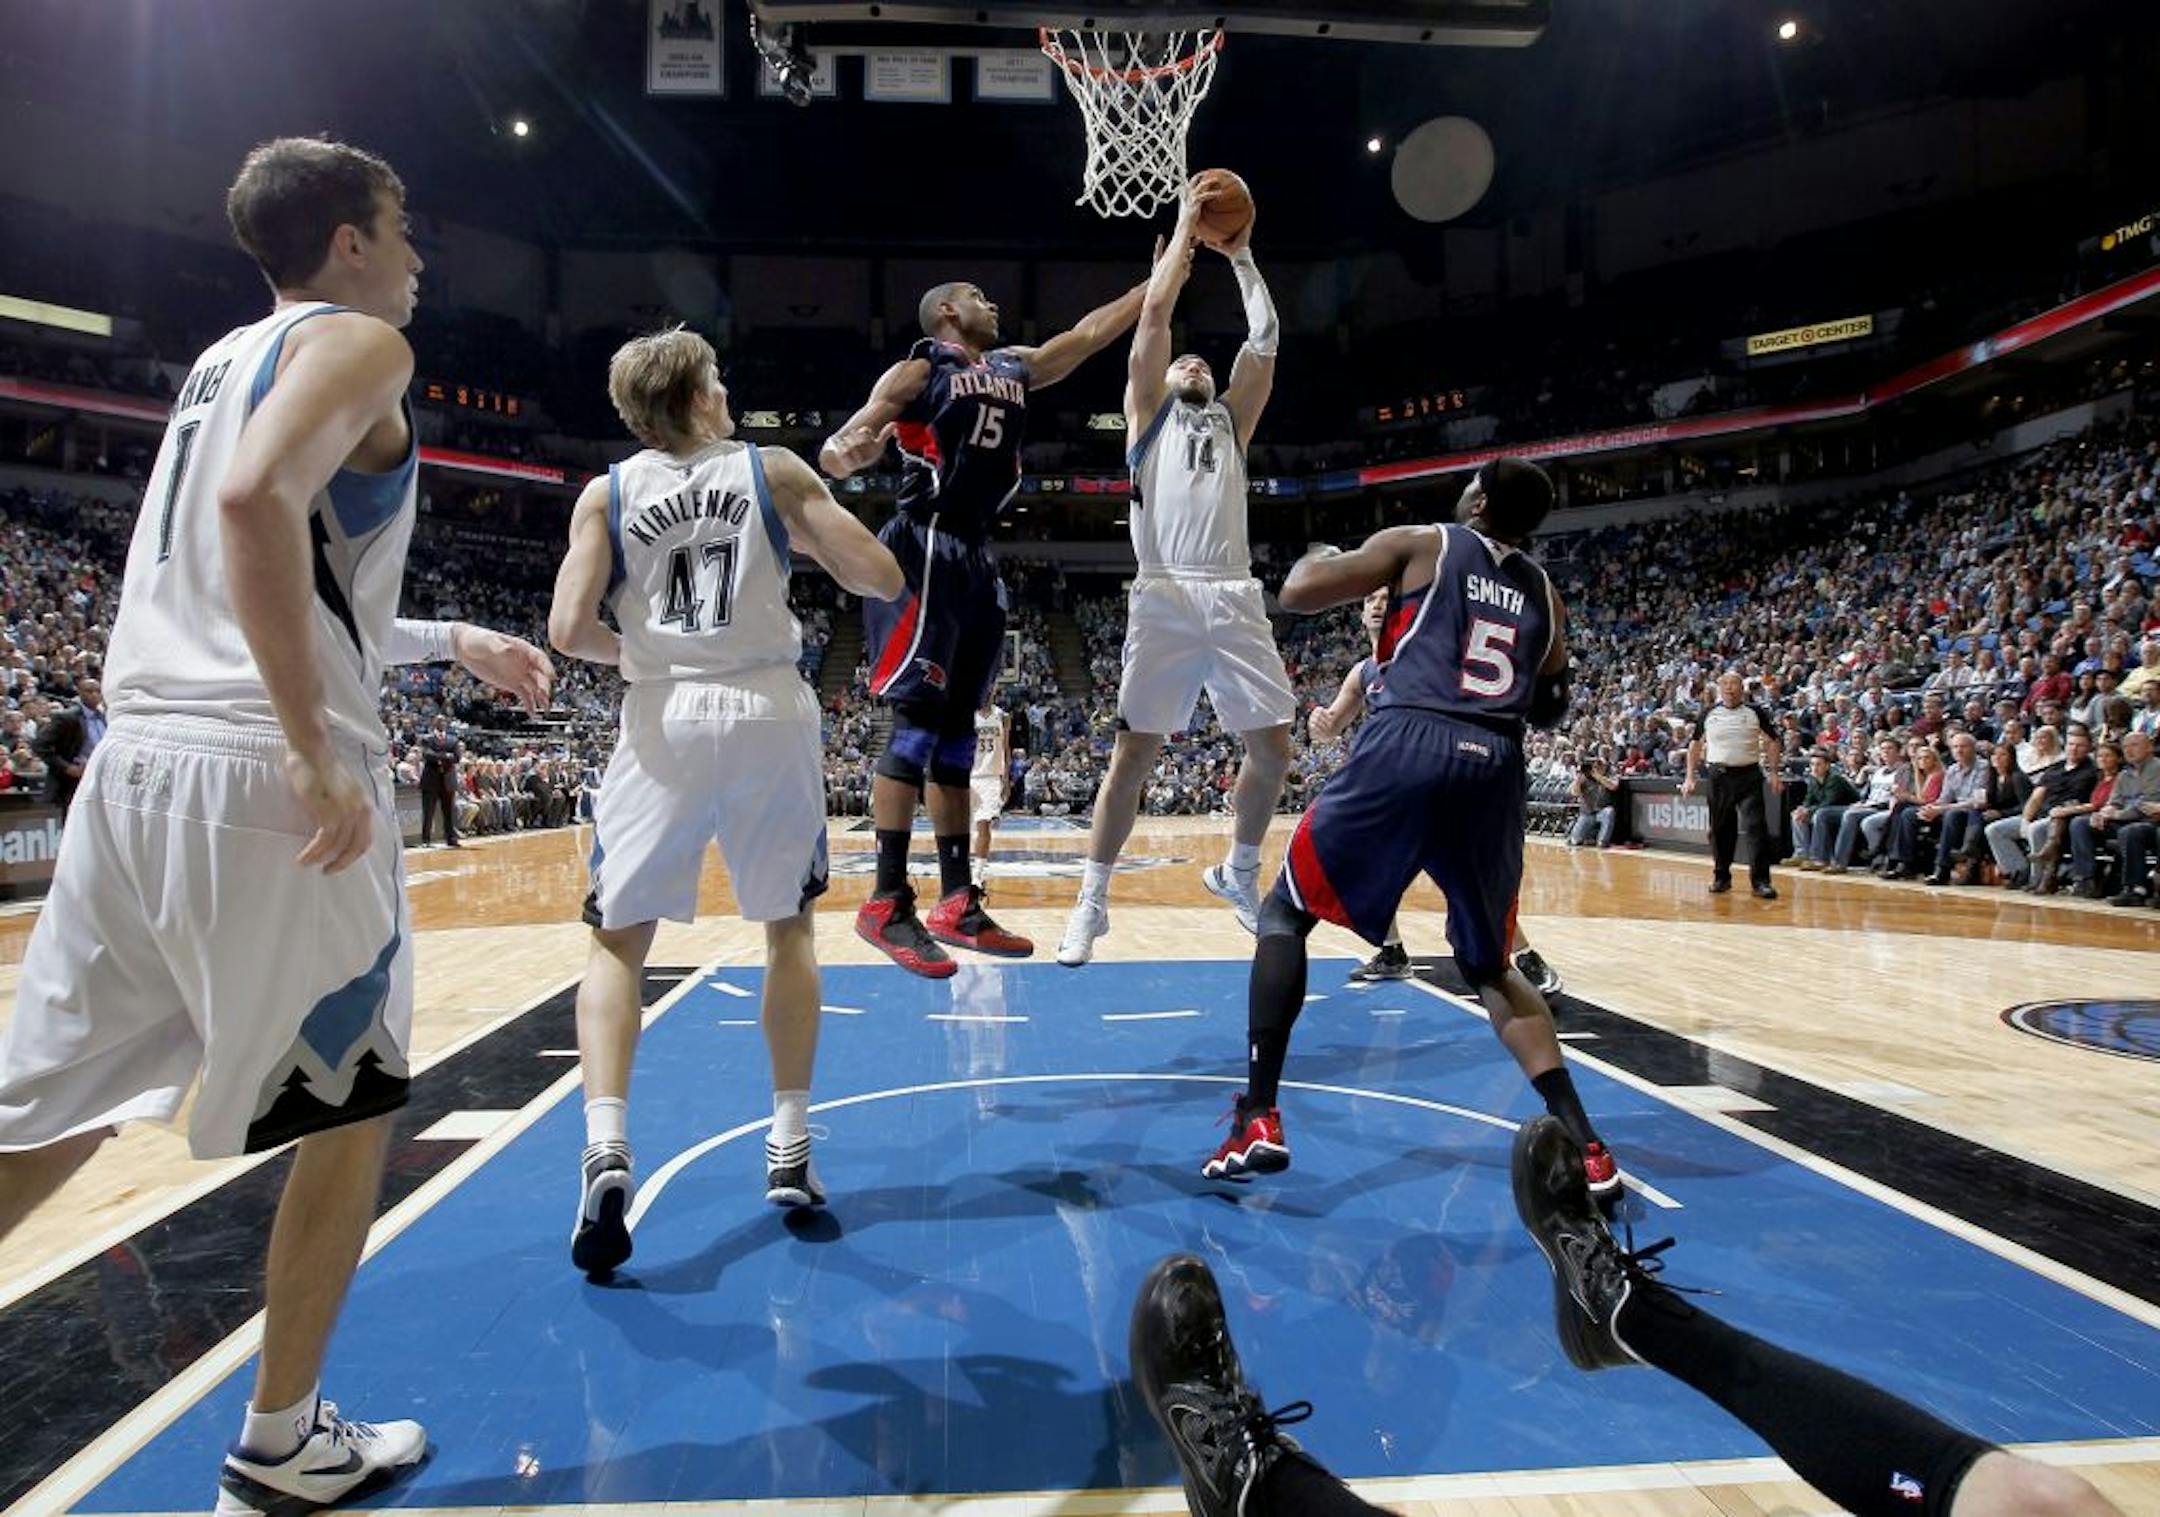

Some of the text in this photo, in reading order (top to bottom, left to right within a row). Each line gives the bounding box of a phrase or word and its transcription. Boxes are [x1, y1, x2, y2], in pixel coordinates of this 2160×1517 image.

[1751, 320, 1869, 350] TARGET CENTER
[949, 370, 1026, 409] ATLANTA
[968, 402, 1006, 449] 15
[1185, 432, 1216, 473] 14
[156, 420, 202, 565] 1
[627, 488, 751, 548] KIRILENKO
[659, 534, 739, 633] 47
[1466, 573, 1526, 616] SMITH
[1460, 615, 1519, 699] 5
[0, 818, 63, 864] ank
